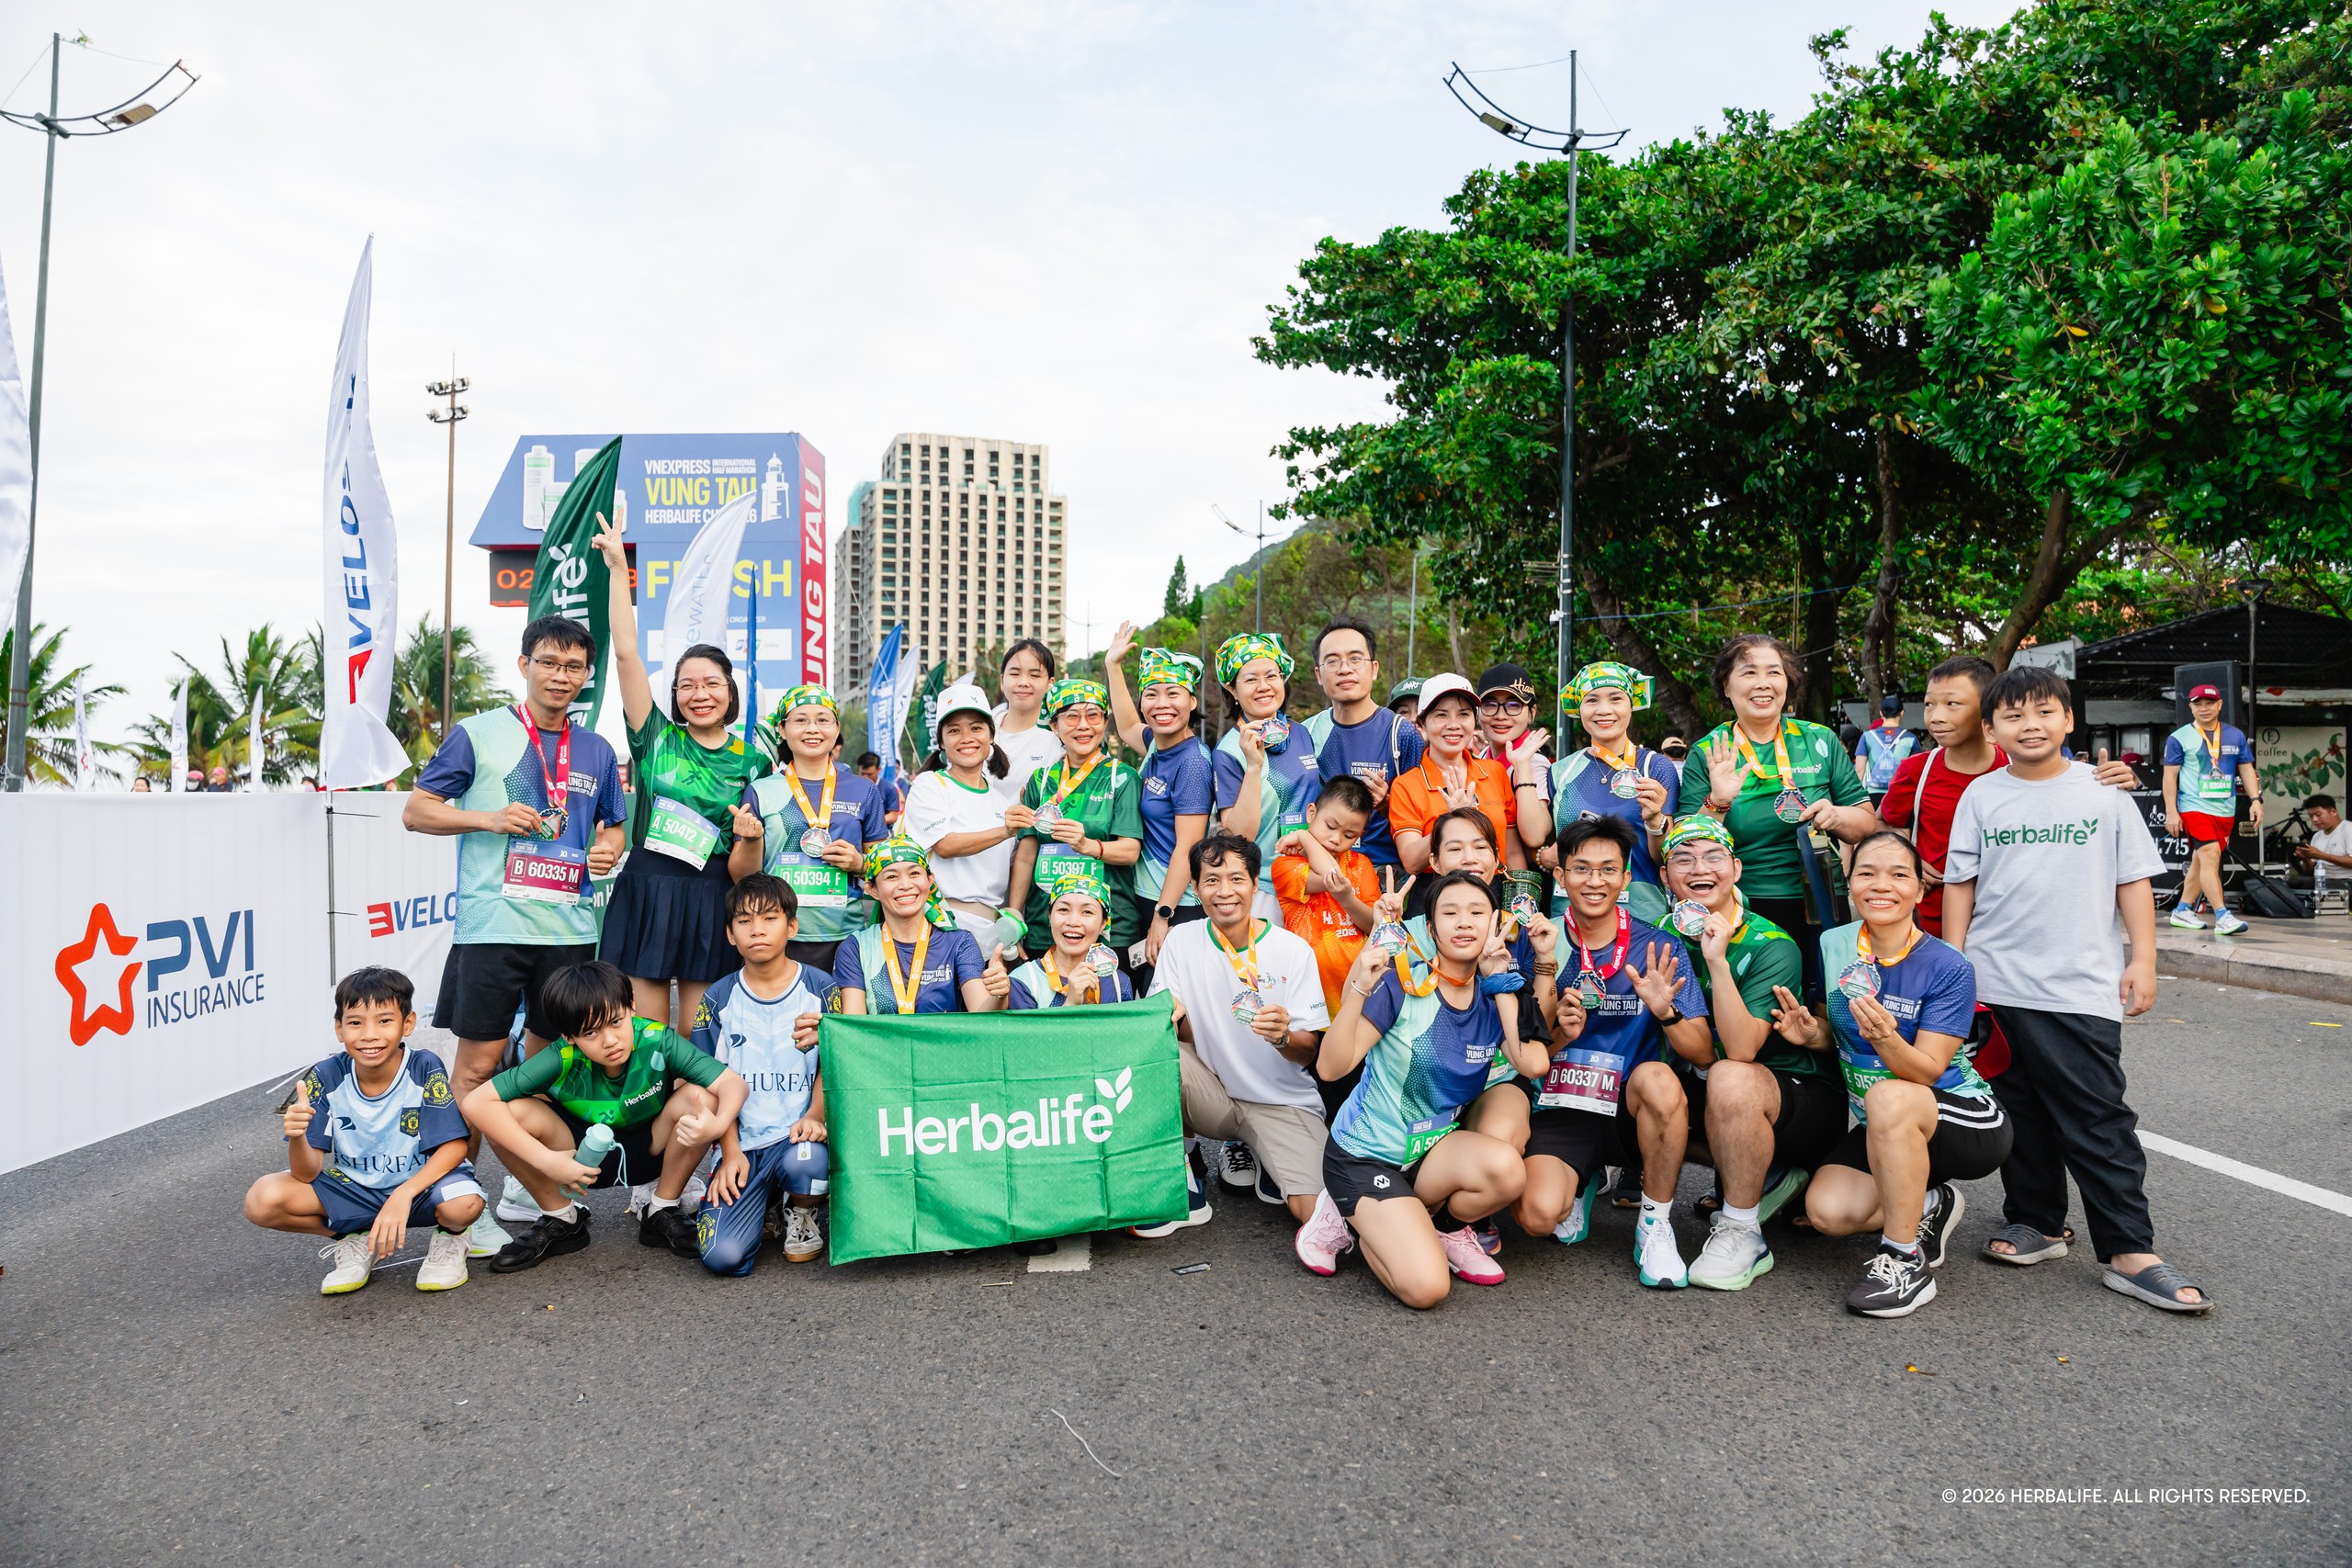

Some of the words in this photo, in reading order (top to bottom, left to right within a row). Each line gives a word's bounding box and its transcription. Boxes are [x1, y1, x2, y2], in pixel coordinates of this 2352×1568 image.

[645, 459, 711, 474] VNEXPRESS
[645, 478, 710, 505] VUNG
[645, 509, 701, 524] HERBALIFE
[805, 467, 825, 566] TAU
[806, 579, 824, 685] UNG
[2257, 748, 2288, 757] coffee
[1791, 765, 1820, 773] erbalife
[569, 777, 582, 788] UNG
[651, 815, 662, 829] A
[662, 818, 697, 842] 50412
[699, 837, 709, 848] F
[1984, 823, 2088, 848] Herbalife
[514, 860, 525, 875] B
[527, 862, 567, 882] 60335
[568, 868, 580, 884] M
[1041, 861, 1049, 874] B
[1052, 861, 1085, 875] 50397
[1091, 862, 1097, 875] F
[793, 871, 831, 886] 50394
[835, 872, 841, 886] F
[147, 909, 254, 992] PVI
[147, 974, 265, 1029] INSURANCE
[1623, 1000, 1636, 1010] TAU
[1883, 999, 1900, 1010] VUNG
[1901, 1003, 1914, 1013] TAU
[1466, 1050, 1485, 1059] VUNG
[1550, 1069, 1558, 1084] D
[1560, 1068, 1600, 1088] 60337
[1601, 1074, 1615, 1091] M
[624, 1084, 662, 1108] Herbalife
[878, 1093, 1114, 1157] Herbalife
[1412, 1139, 1421, 1155] A
